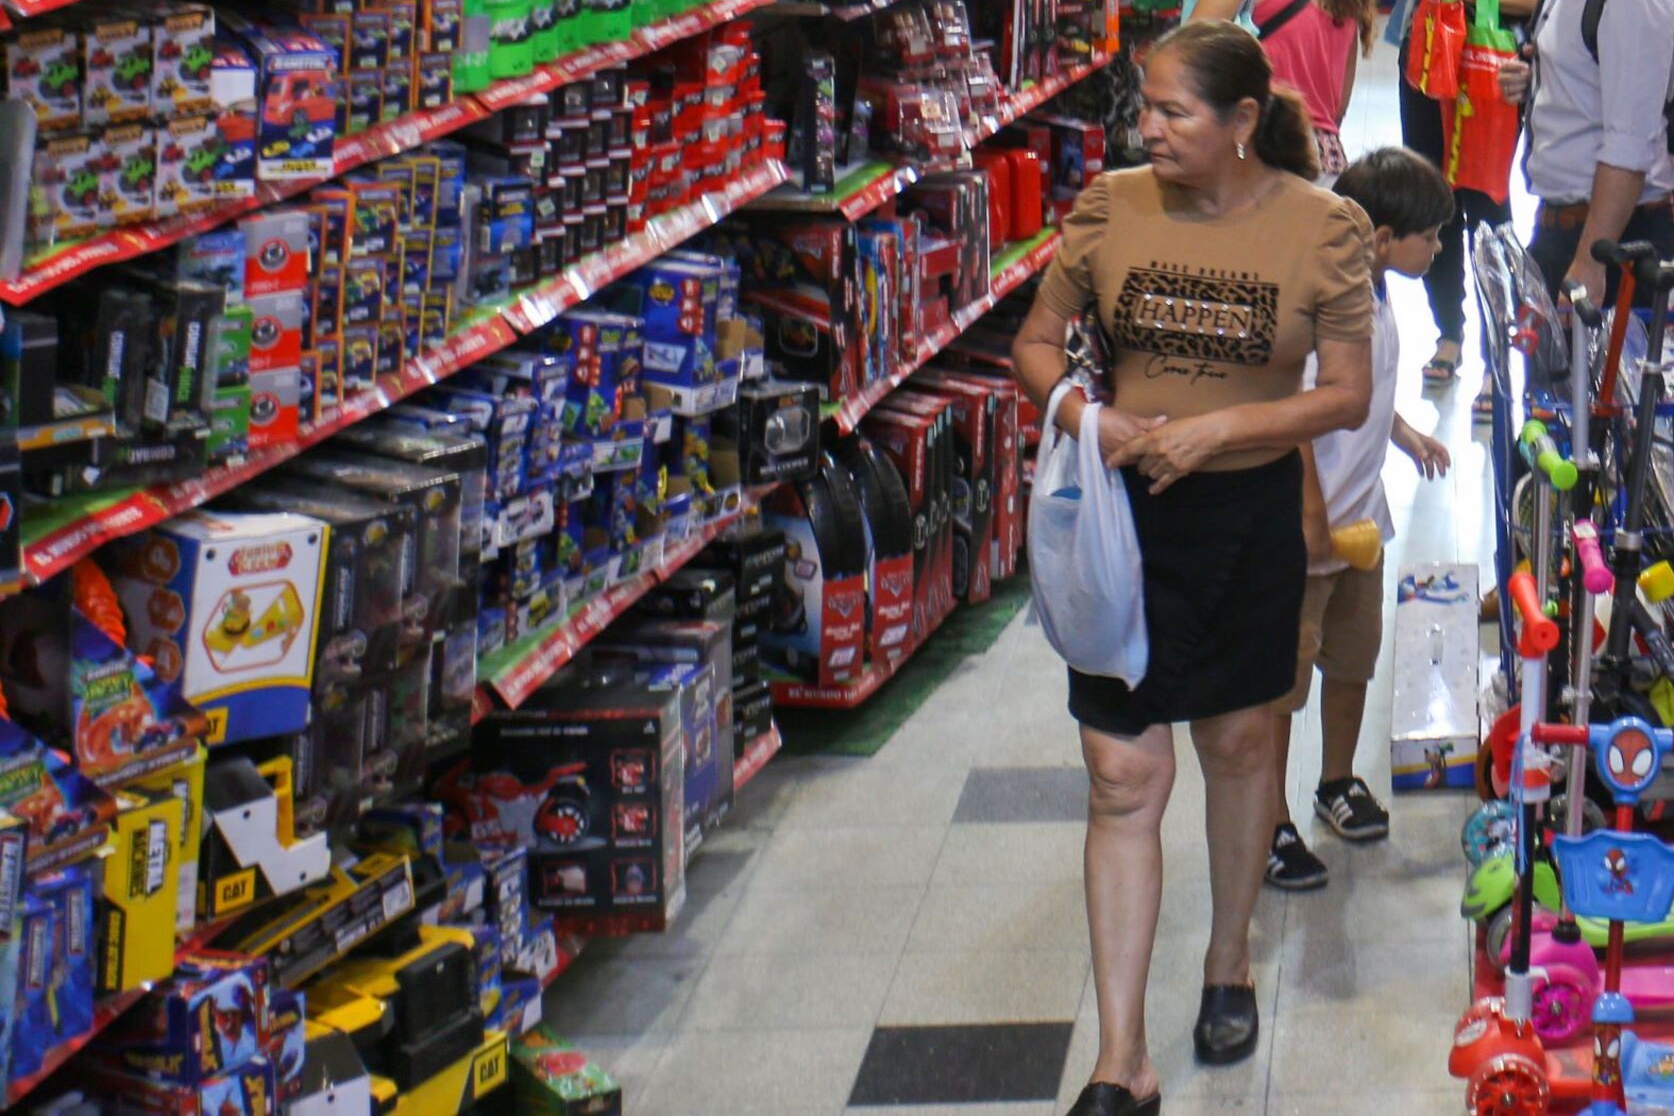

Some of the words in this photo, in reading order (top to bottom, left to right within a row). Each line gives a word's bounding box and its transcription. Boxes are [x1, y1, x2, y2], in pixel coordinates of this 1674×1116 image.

[1139, 301, 1249, 331] HAPPEN
[222, 879, 248, 904] CAT
[479, 1055, 500, 1084] CAT
